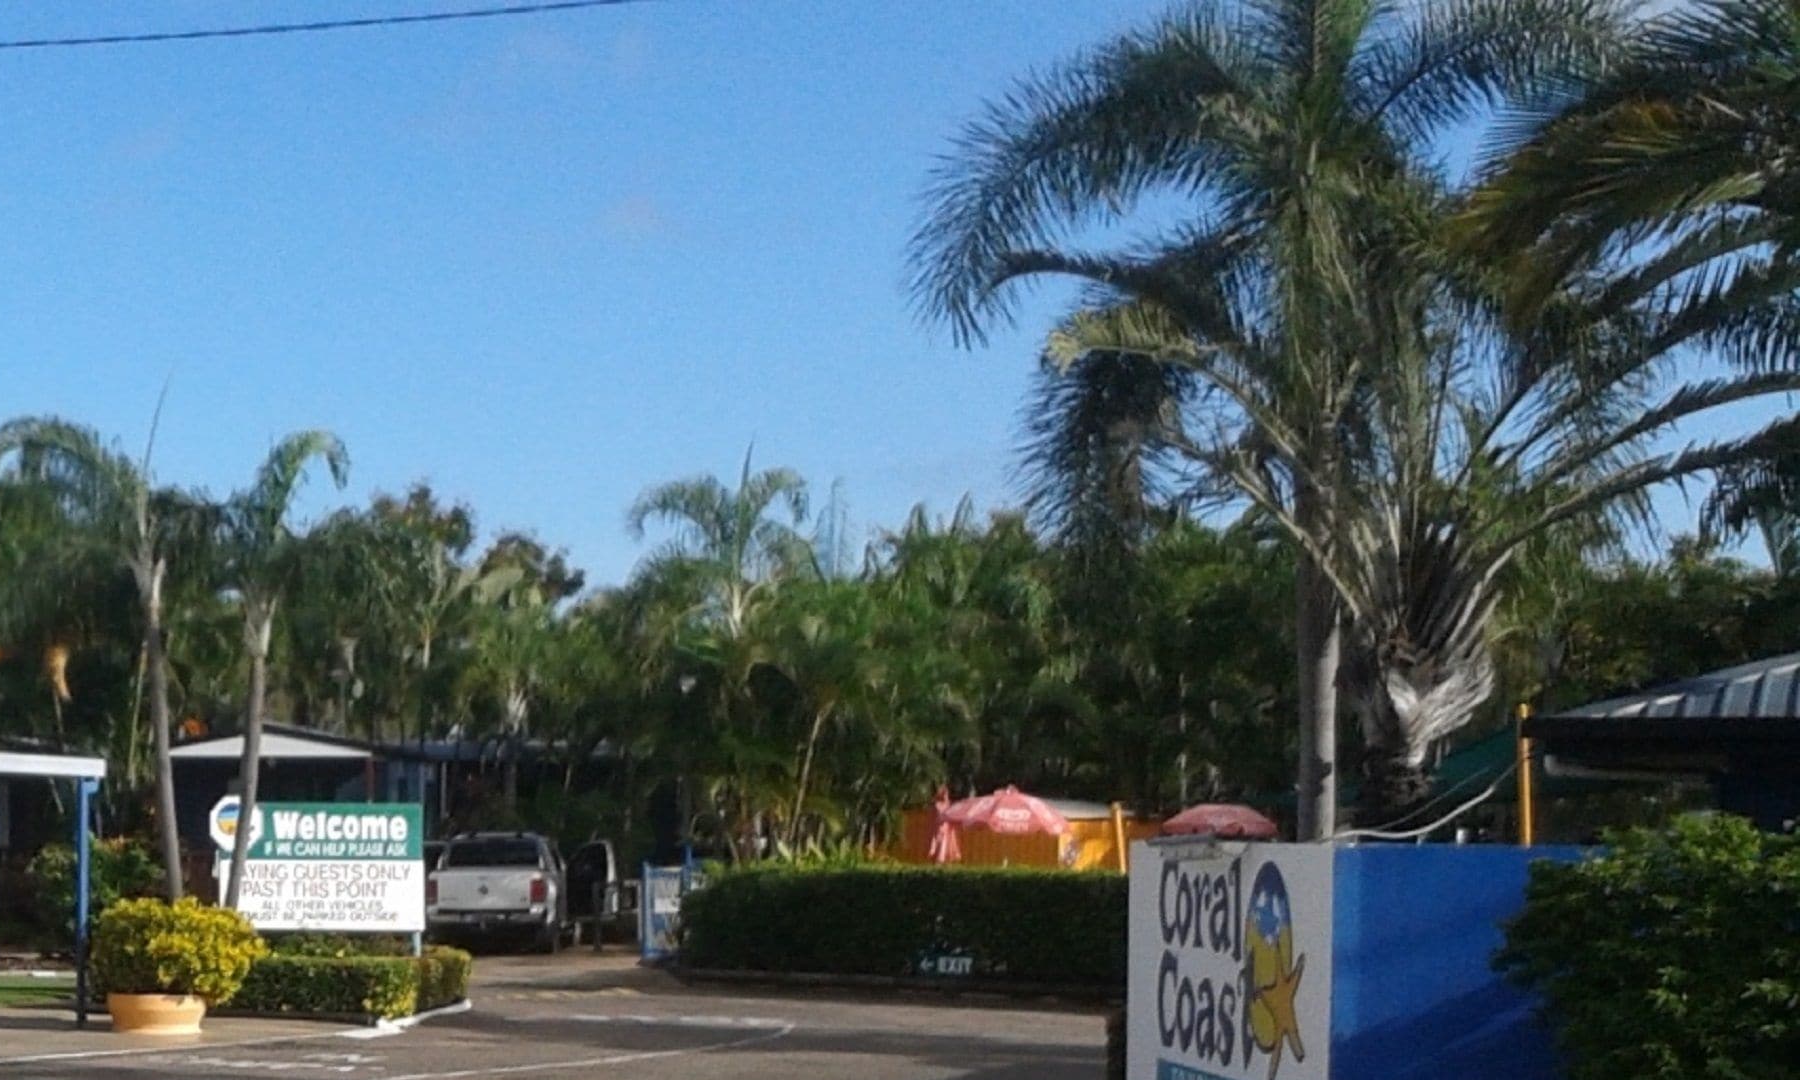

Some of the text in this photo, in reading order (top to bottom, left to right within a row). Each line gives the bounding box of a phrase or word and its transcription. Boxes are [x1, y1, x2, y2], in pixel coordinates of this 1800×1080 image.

[273, 811, 408, 841] Welcome
[294, 842, 320, 856] CAN
[348, 842, 384, 856] PLEASE
[387, 842, 408, 856] ASK
[293, 864, 363, 880] GUESTS
[366, 864, 410, 881] ONLY
[241, 880, 388, 898] PAST THIS POINT
[285, 901, 324, 910] OTHER
[1159, 857, 1242, 962] Coral
[937, 956, 973, 974] EXIT
[1157, 949, 1255, 1071] Coast
